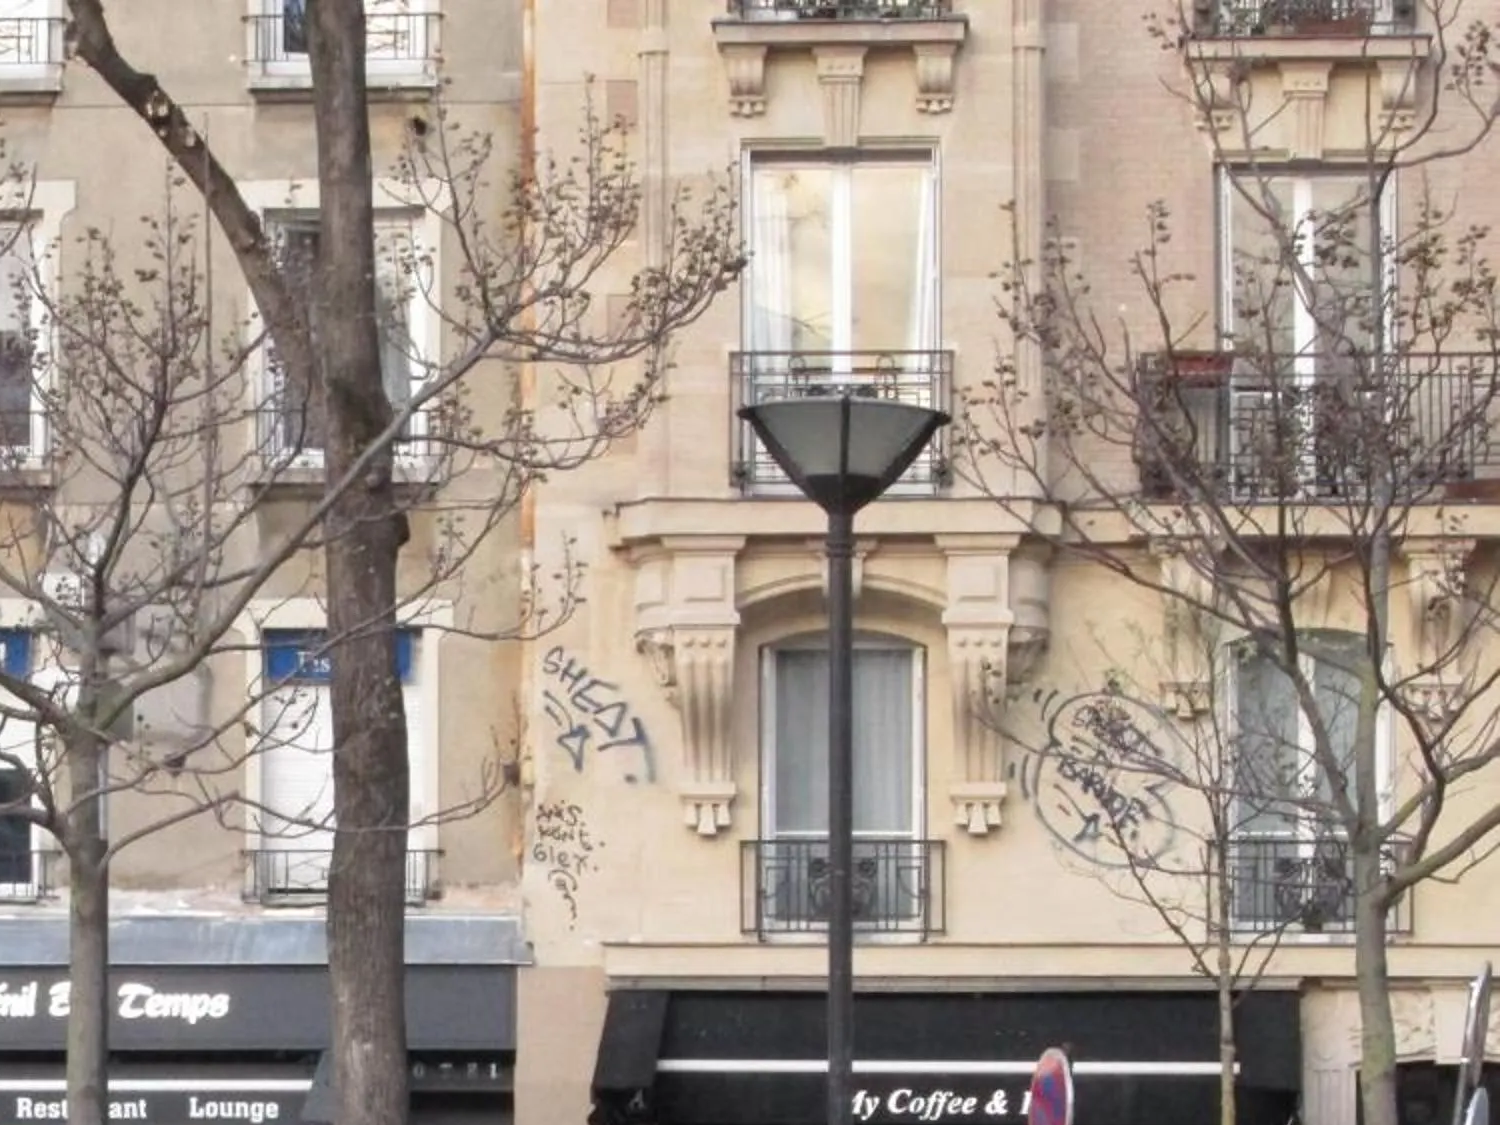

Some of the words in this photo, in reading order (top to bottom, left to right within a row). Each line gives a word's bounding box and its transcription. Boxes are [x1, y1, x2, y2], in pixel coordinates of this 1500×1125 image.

[117, 983, 230, 1024] Temps
[16, 1097, 147, 1119] Restant
[189, 1096, 279, 1123] Lounge
[887, 1089, 978, 1121] Coffee
[985, 1089, 1008, 1115] &
